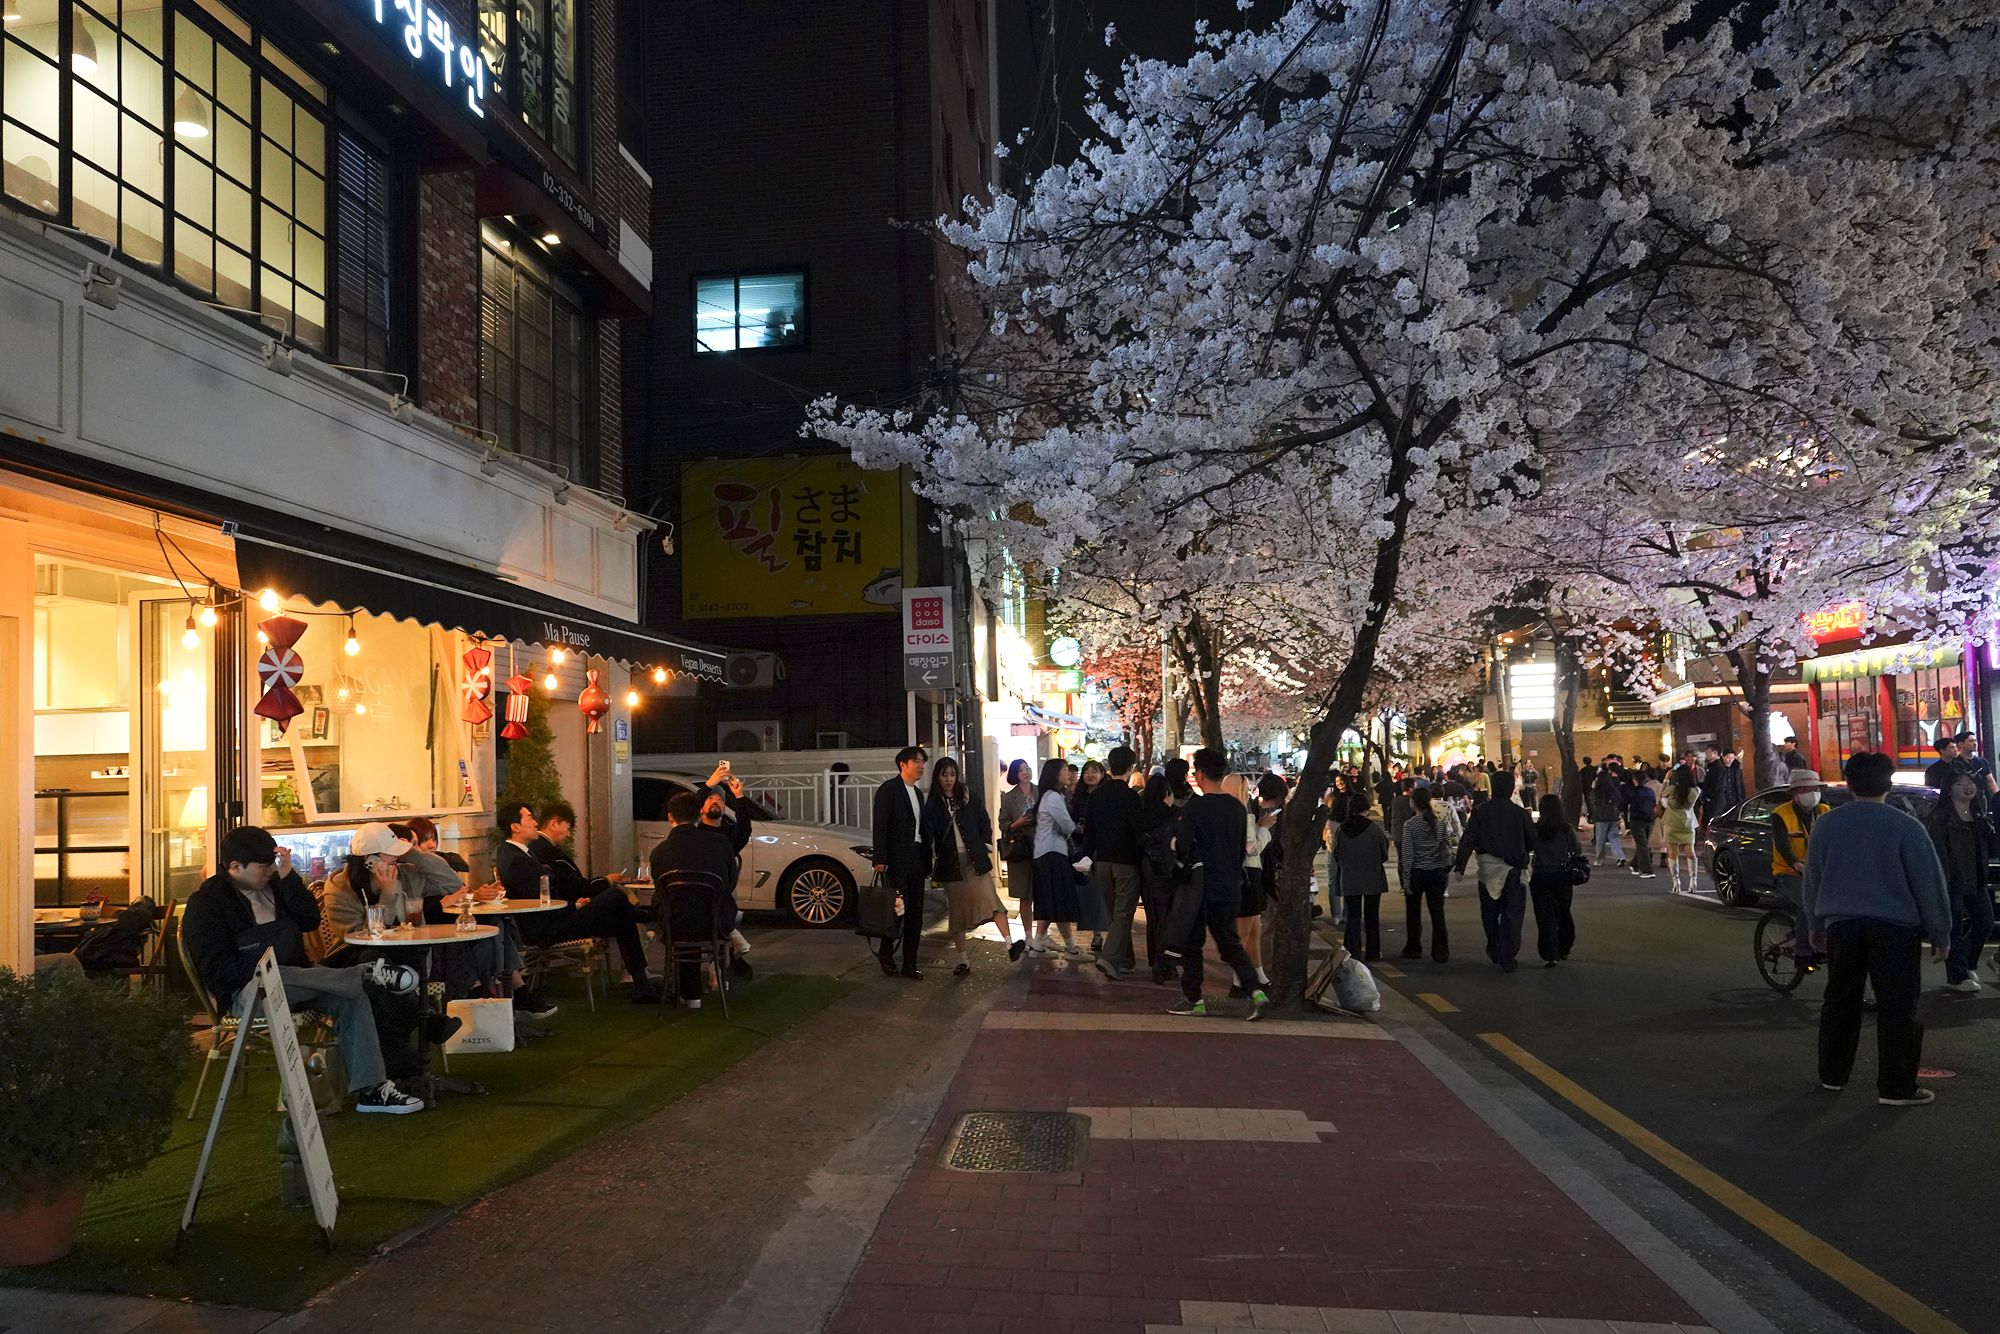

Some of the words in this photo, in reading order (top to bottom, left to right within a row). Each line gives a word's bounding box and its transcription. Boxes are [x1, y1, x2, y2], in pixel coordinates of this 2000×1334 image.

[543, 171, 595, 232] 02-332-6391
[792, 484, 861, 524] さま
[793, 528, 862, 572] 참치
[543, 621, 560, 642] Ma
[561, 625, 591, 648] Pause
[907, 633, 950, 645] 다이소
[680, 654, 699, 670] Vegan
[699, 660, 722, 676] Desserts
[909, 656, 949, 669] 매장입구
